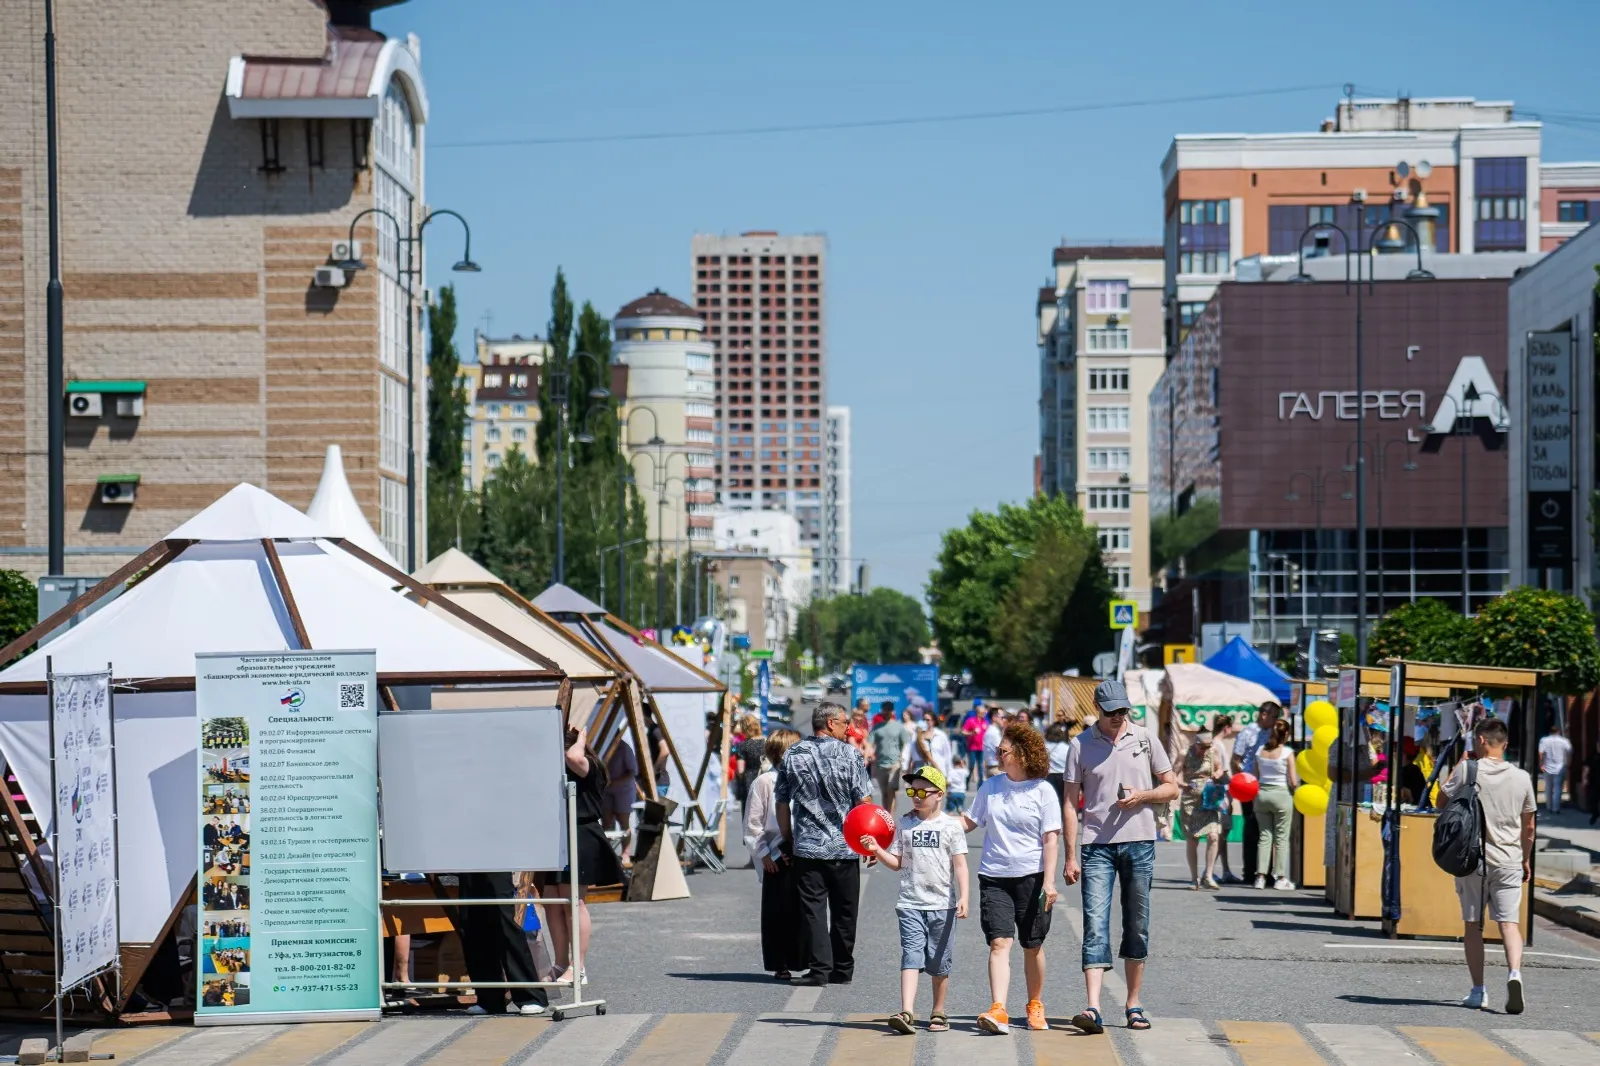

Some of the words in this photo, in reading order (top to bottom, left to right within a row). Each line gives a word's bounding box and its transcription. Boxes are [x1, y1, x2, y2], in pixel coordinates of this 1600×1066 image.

[1532, 362, 1556, 376] УНИ
[1278, 390, 1425, 420] ГАЛЕРЕЯ
[1431, 356, 1511, 433] А
[1532, 383, 1566, 398] КАЛЬ
[1532, 424, 1571, 441] ВЫБОР
[1533, 445, 1548, 460] ЗА
[268, 656, 332, 664] профессиональное
[294, 663, 336, 671] учреждение
[250, 671, 335, 680] экономико-юридический
[268, 716, 334, 724] Специальности:
[286, 774, 354, 782] Правоохранительная
[287, 794, 338, 802] Юриспруденция
[913, 830, 938, 843] SEA
[287, 852, 311, 860] Дизайн
[312, 852, 322, 860] (по
[323, 851, 357, 859] отраслям)
[264, 867, 320, 875] Государственный
[264, 890, 295, 898] Практика
[301, 889, 346, 897] организациях
[264, 919, 314, 927] Преподаватели
[271, 939, 313, 947] Приемная
[274, 952, 292, 960] Уфа,
[292, 952, 304, 960] ул.
[305, 950, 356, 959] Энтузиастов,
[291, 964, 356, 972] 8-800-201-82-02
[290, 984, 359, 992] +7-937-471-55-23
